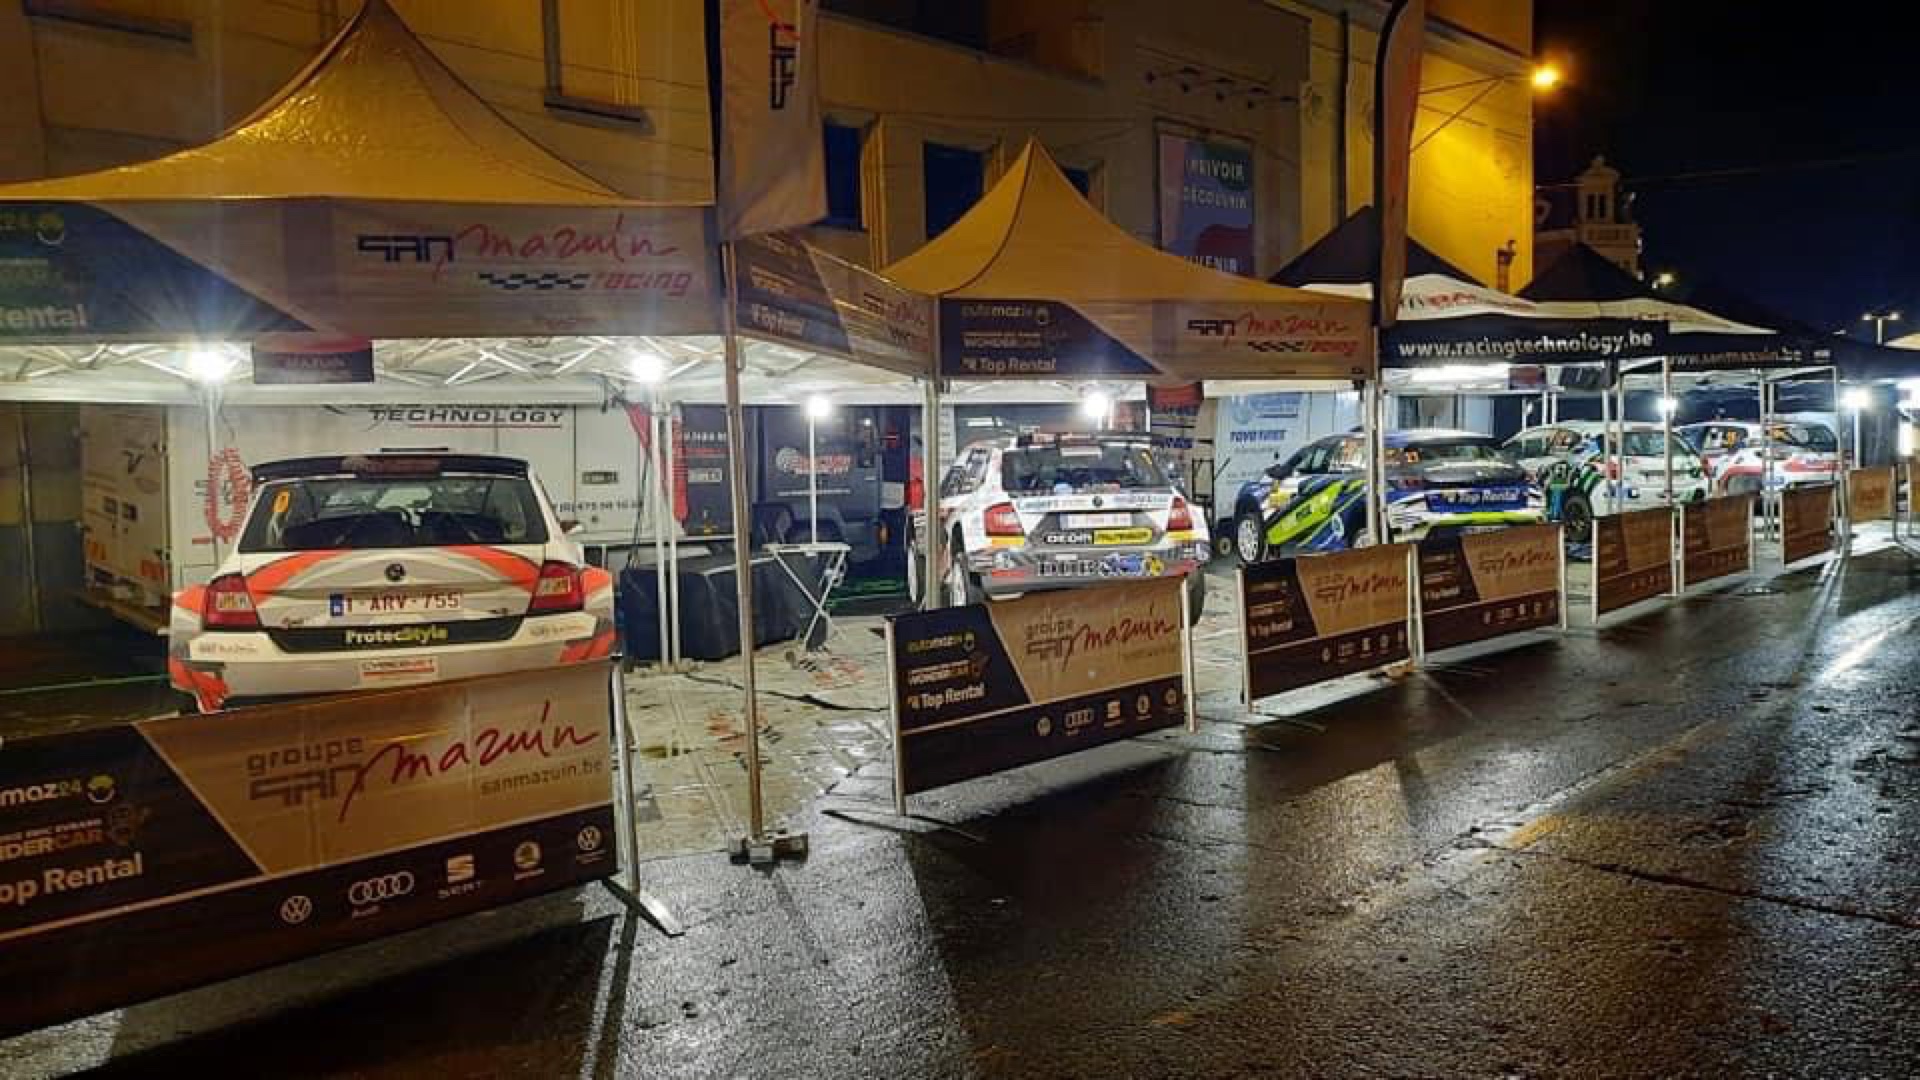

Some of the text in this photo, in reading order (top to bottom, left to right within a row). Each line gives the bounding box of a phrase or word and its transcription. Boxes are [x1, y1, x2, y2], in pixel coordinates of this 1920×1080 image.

[599, 272, 691, 296] racing
[1399, 331, 1653, 358] www.racingtechnology.be
[369, 409, 564, 424] TECHNOLOGY
[247, 737, 365, 776] groupe
[480, 760, 603, 797] sanmazuin.be
[0, 828, 104, 862] DERCAR
[43, 851, 143, 894] Rental
